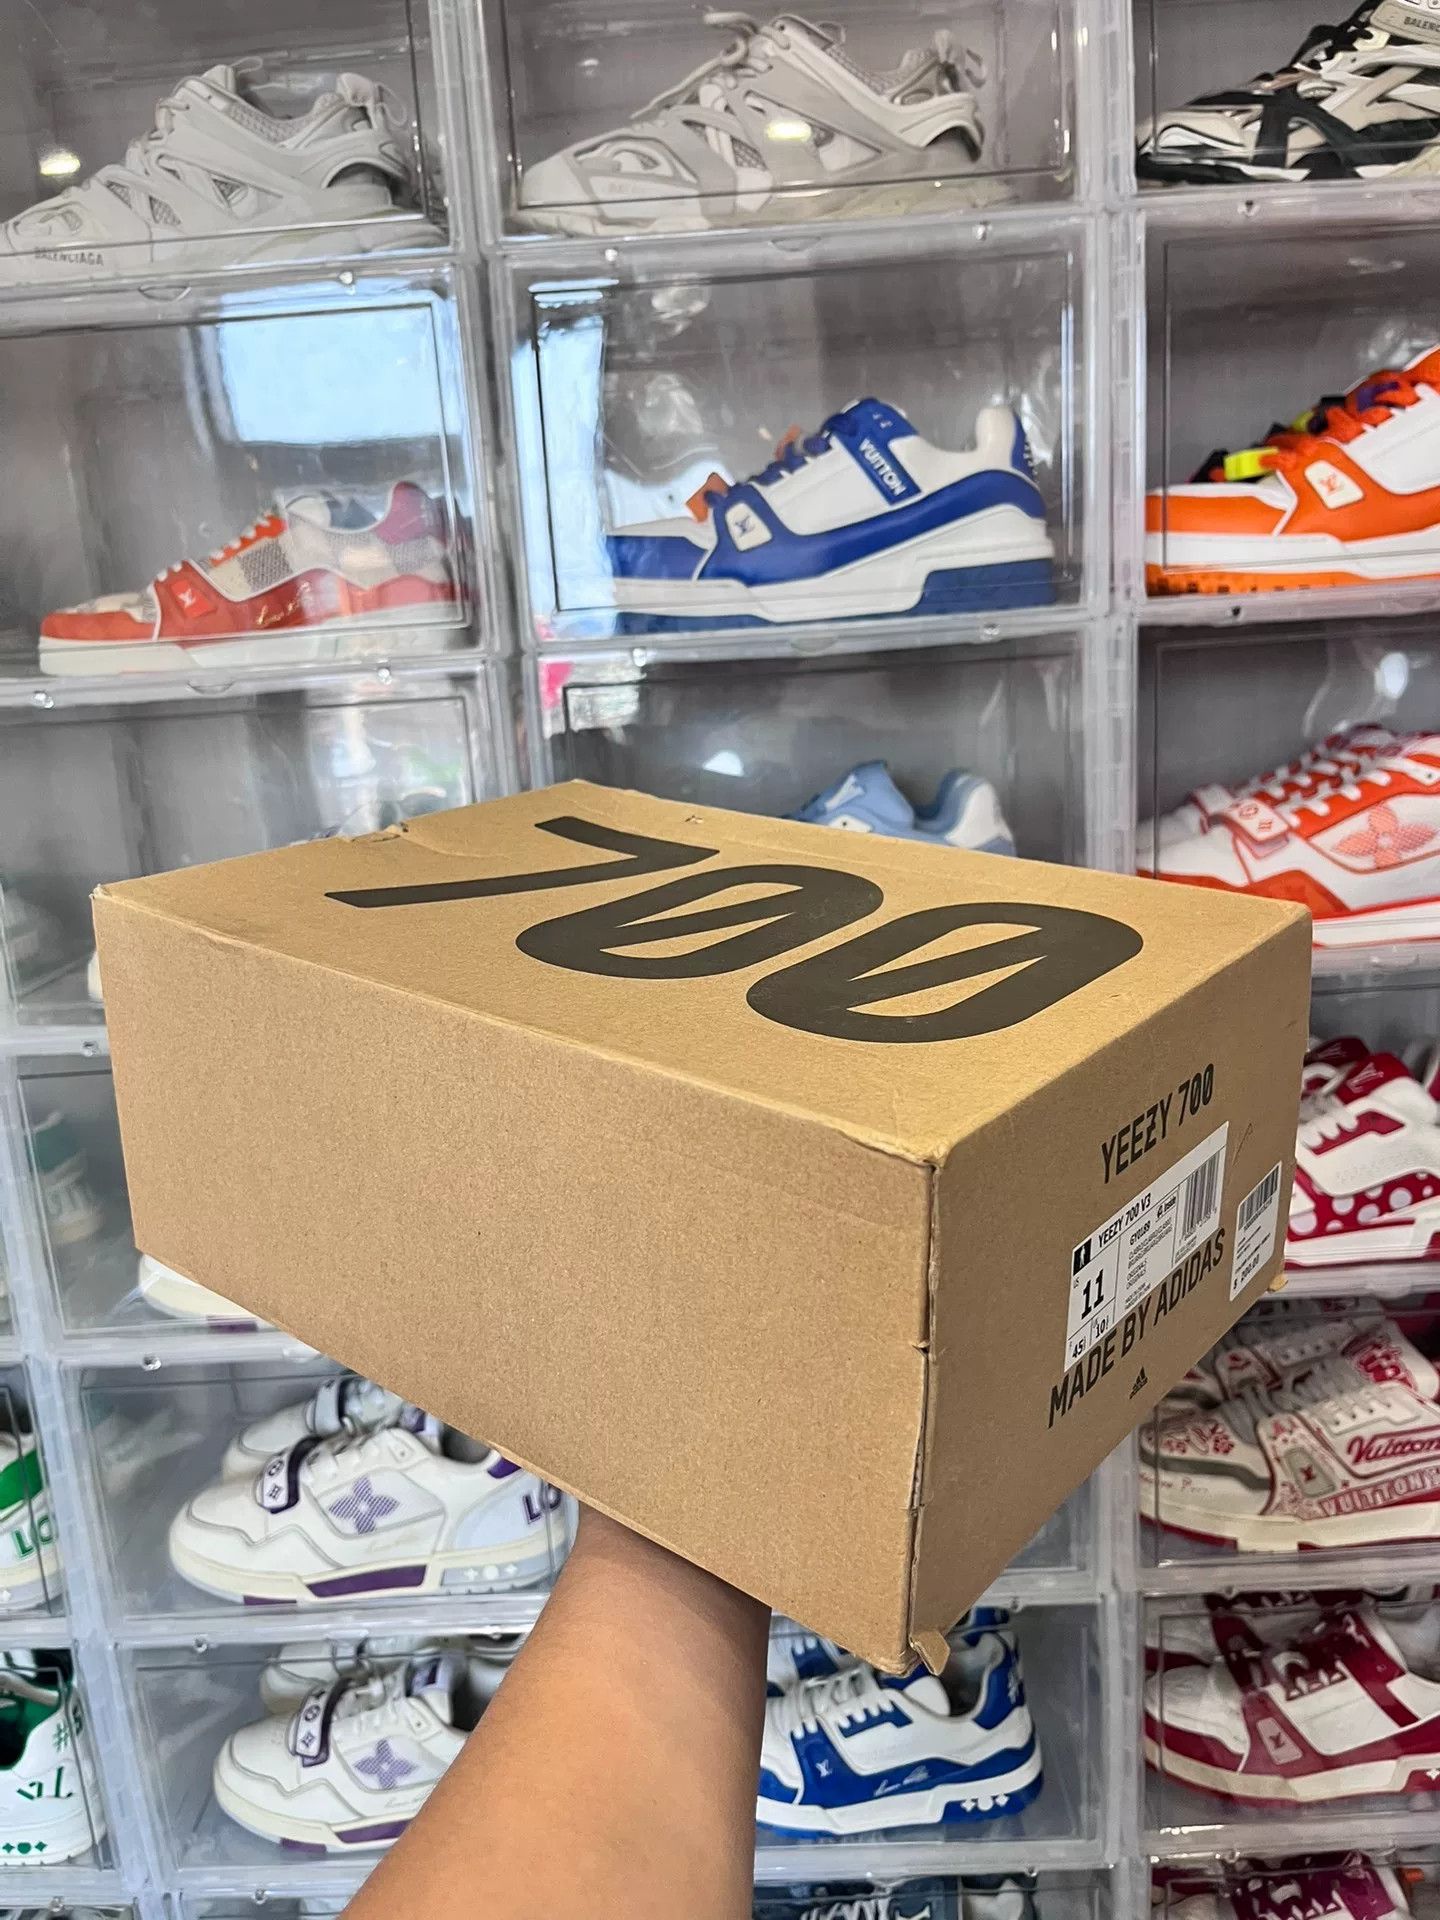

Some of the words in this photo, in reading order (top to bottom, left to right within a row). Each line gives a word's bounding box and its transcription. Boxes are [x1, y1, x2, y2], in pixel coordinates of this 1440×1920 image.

[858, 437, 907, 496] VUITTON
[325, 815, 1144, 1044] 700
[1101, 1092, 1173, 1185] YEEZY
[1178, 1063, 1214, 1127] 700
[1098, 1216, 1124, 1248] YEEZY
[1125, 1202, 1140, 1226] 700
[1141, 1192, 1151, 1212] V3
[1048, 1328, 1117, 1429] MADE
[1121, 1295, 1152, 1359] BY
[1153, 1227, 1226, 1327] ADIDAS
[1081, 1268, 1105, 1320] 11
